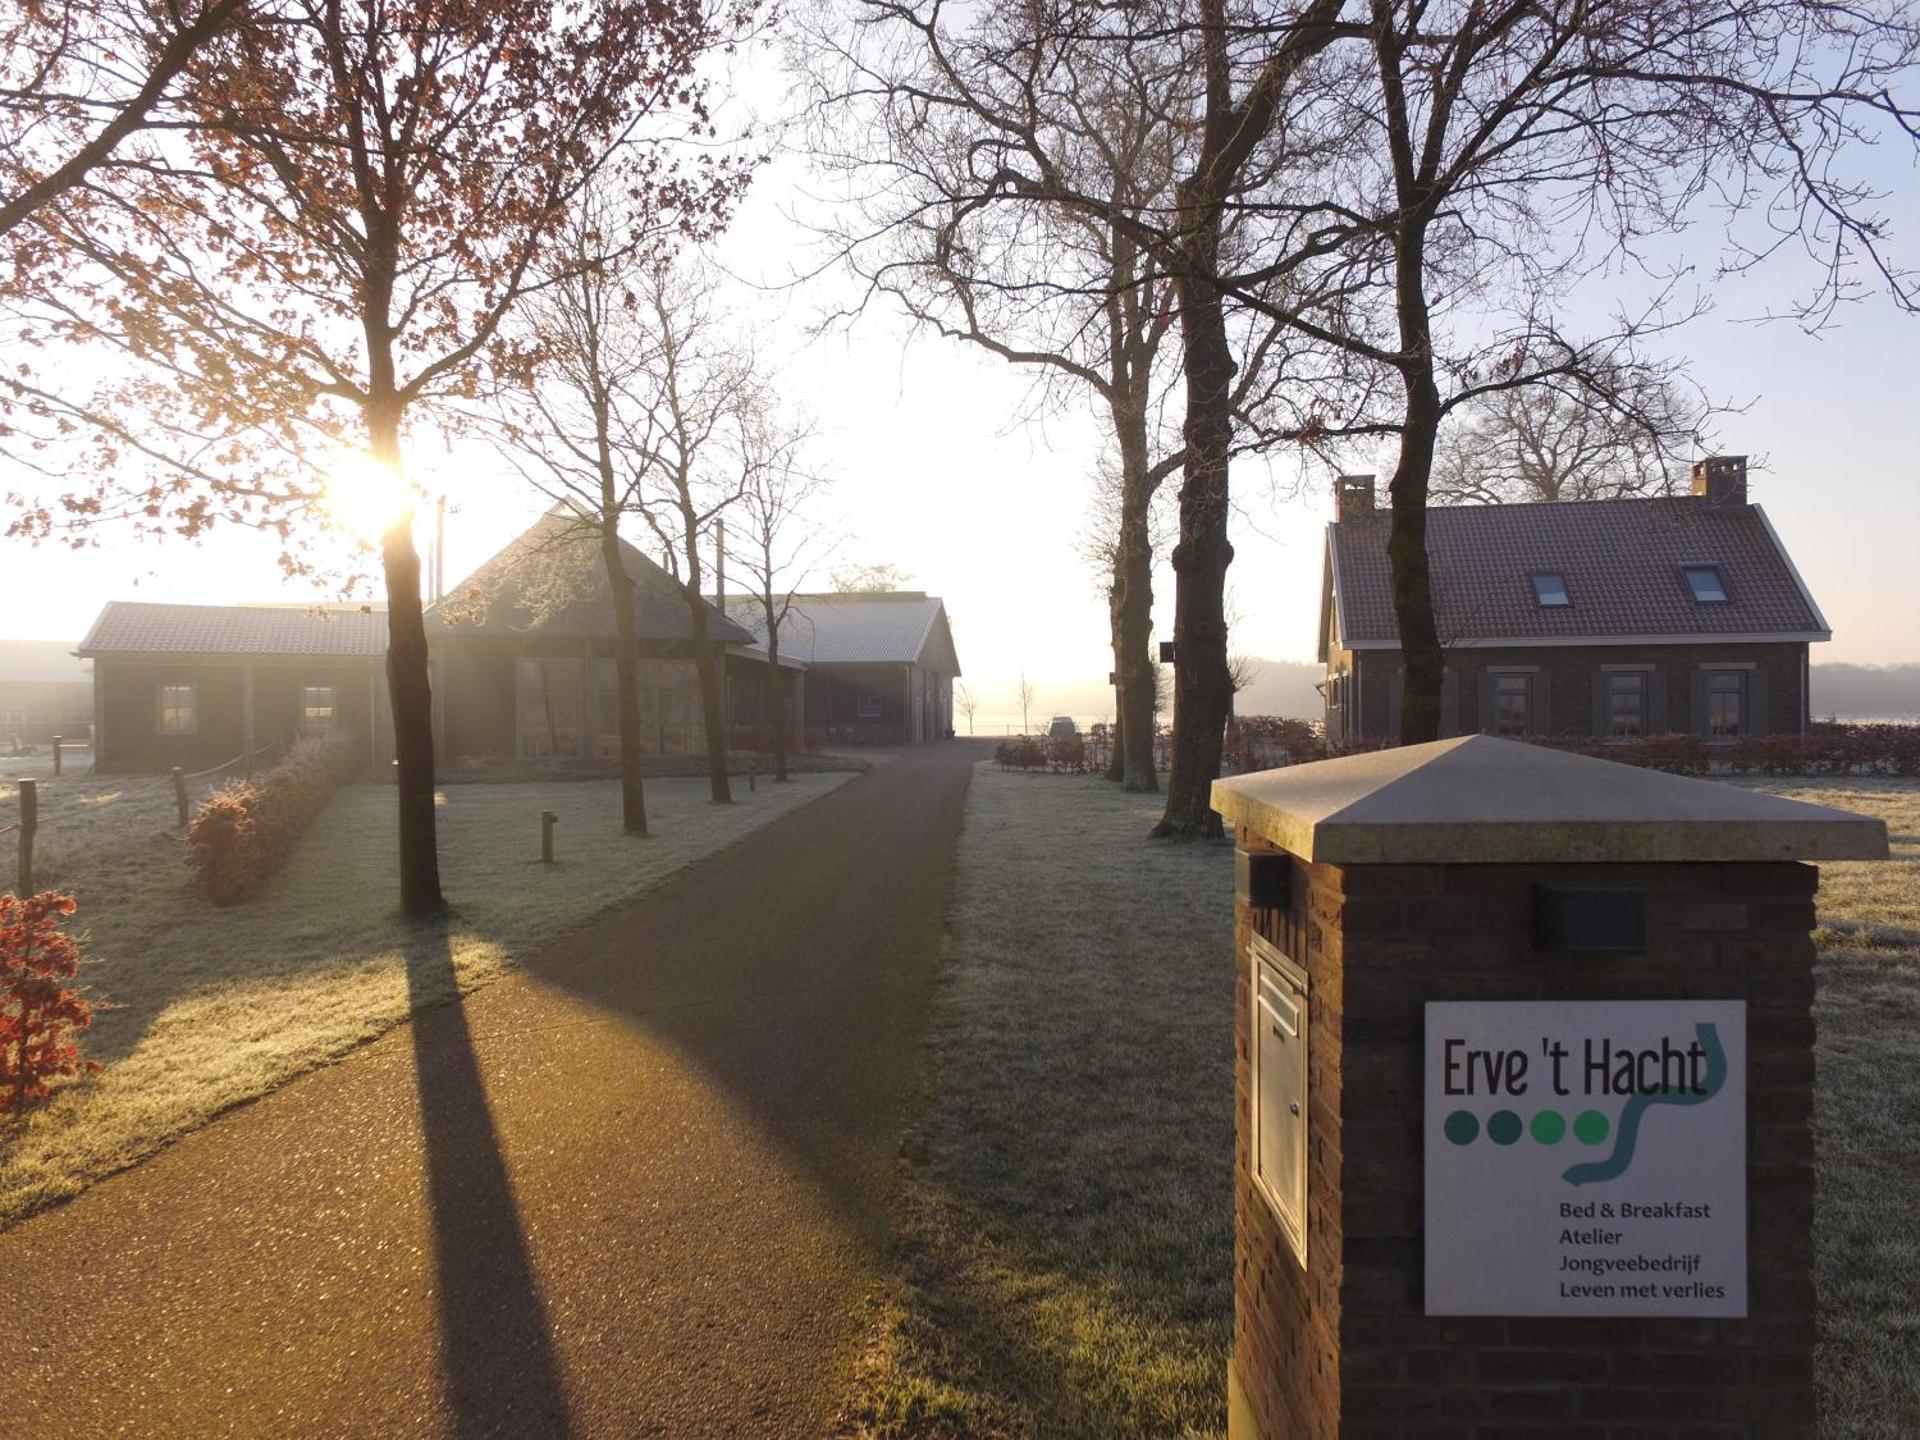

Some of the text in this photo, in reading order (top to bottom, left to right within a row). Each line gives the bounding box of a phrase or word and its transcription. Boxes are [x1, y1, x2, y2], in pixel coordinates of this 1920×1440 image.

[1444, 1036, 1709, 1097] Erve 't Hacht
[1559, 1202, 1712, 1219] Bed & Breakfast
[1559, 1228, 1624, 1246] Atelier
[1559, 1255, 1702, 1277] Jongveebedrijf
[1560, 1282, 1726, 1299] Leven met verlies
